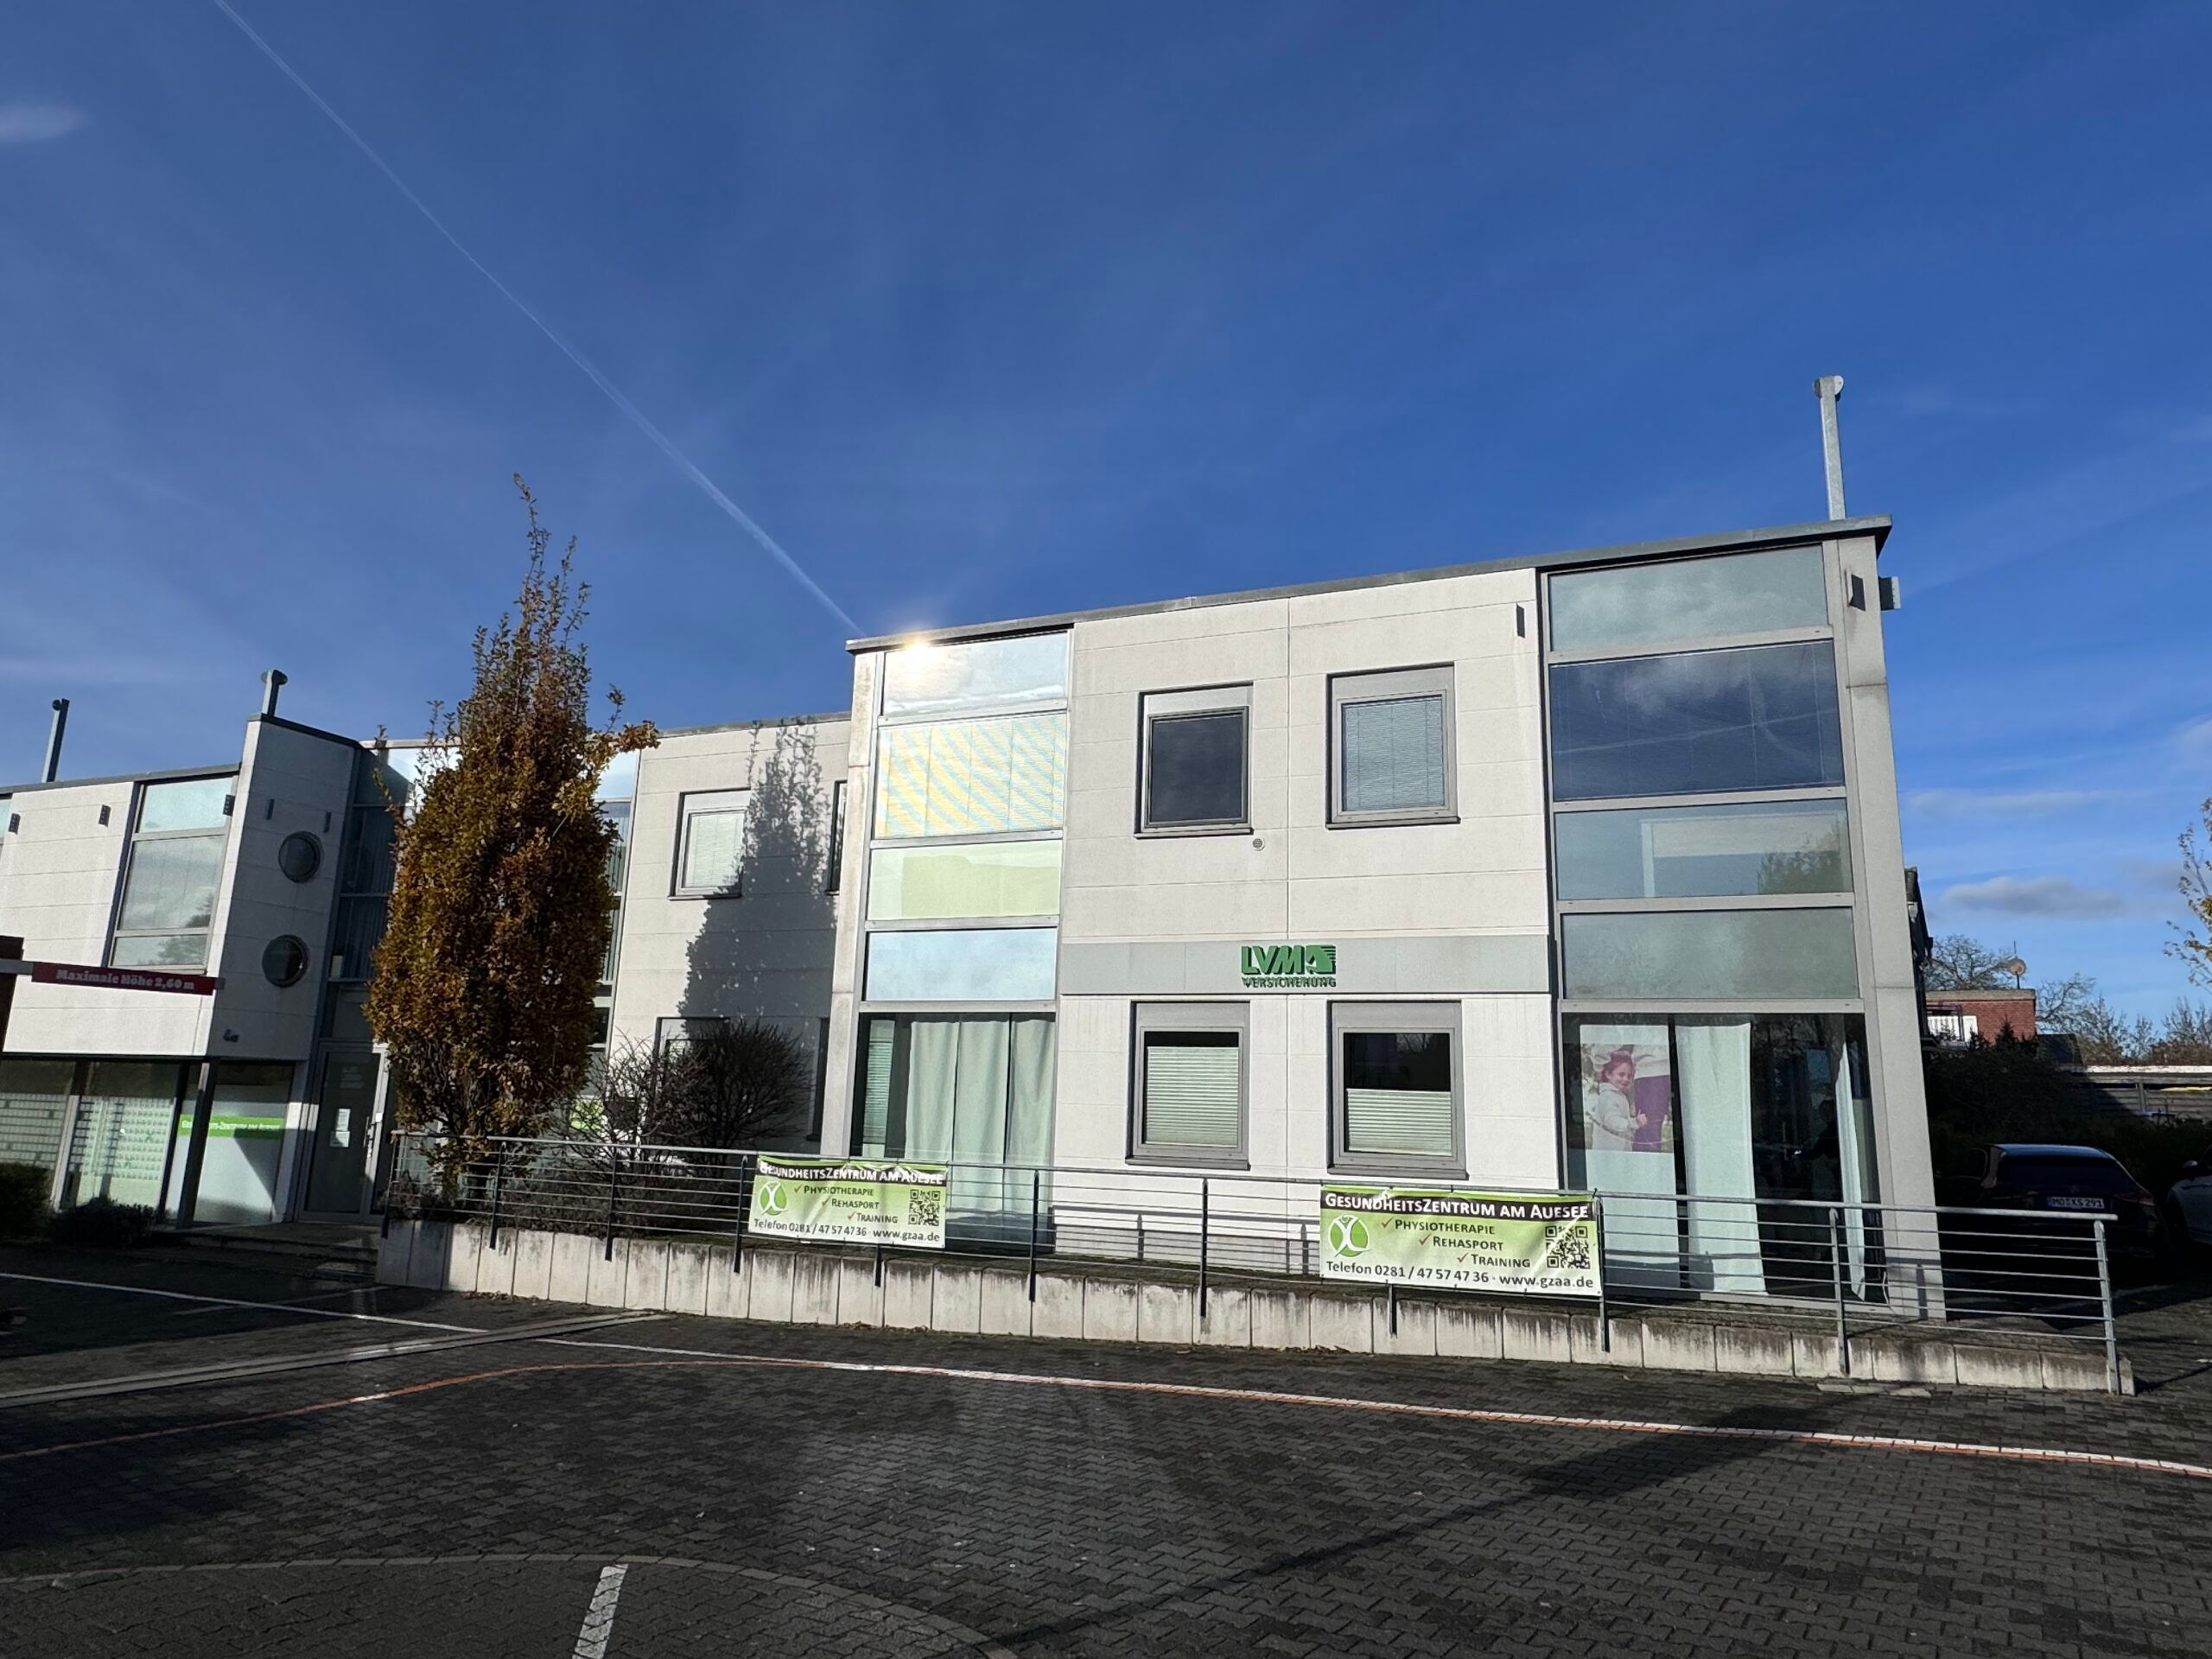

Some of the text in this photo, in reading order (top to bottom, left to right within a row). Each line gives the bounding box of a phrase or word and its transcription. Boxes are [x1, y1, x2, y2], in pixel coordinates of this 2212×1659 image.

[1242, 945, 1306, 976] LVM
[55, 969, 194, 990] Maximale Höhe 2,60 m
[1242, 976, 1337, 988] VERSICHERUNG
[880, 1170, 899, 1182] AM
[804, 1185, 874, 1197] PHYSIOTHERAPIE
[831, 1198, 880, 1210] REHASPORT
[1325, 1192, 1589, 1219] GESUNDHEITSZENTRUM AM AUESEE
[857, 1212, 899, 1224] TRAINING
[753, 1218, 787, 1230] Telefon
[873, 1230, 941, 1242] www.gzaa.de
[1395, 1218, 1496, 1235] PHYSIOTHERAPIE
[1433, 1236, 1503, 1251] REHASPORT
[1471, 1254, 1531, 1268] TRAINING
[1326, 1261, 1372, 1275] Telefon
[1375, 1265, 1406, 1277] 0281
[1417, 1268, 1433, 1279] 47
[1499, 1275, 1594, 1288] www.gzaa.de
